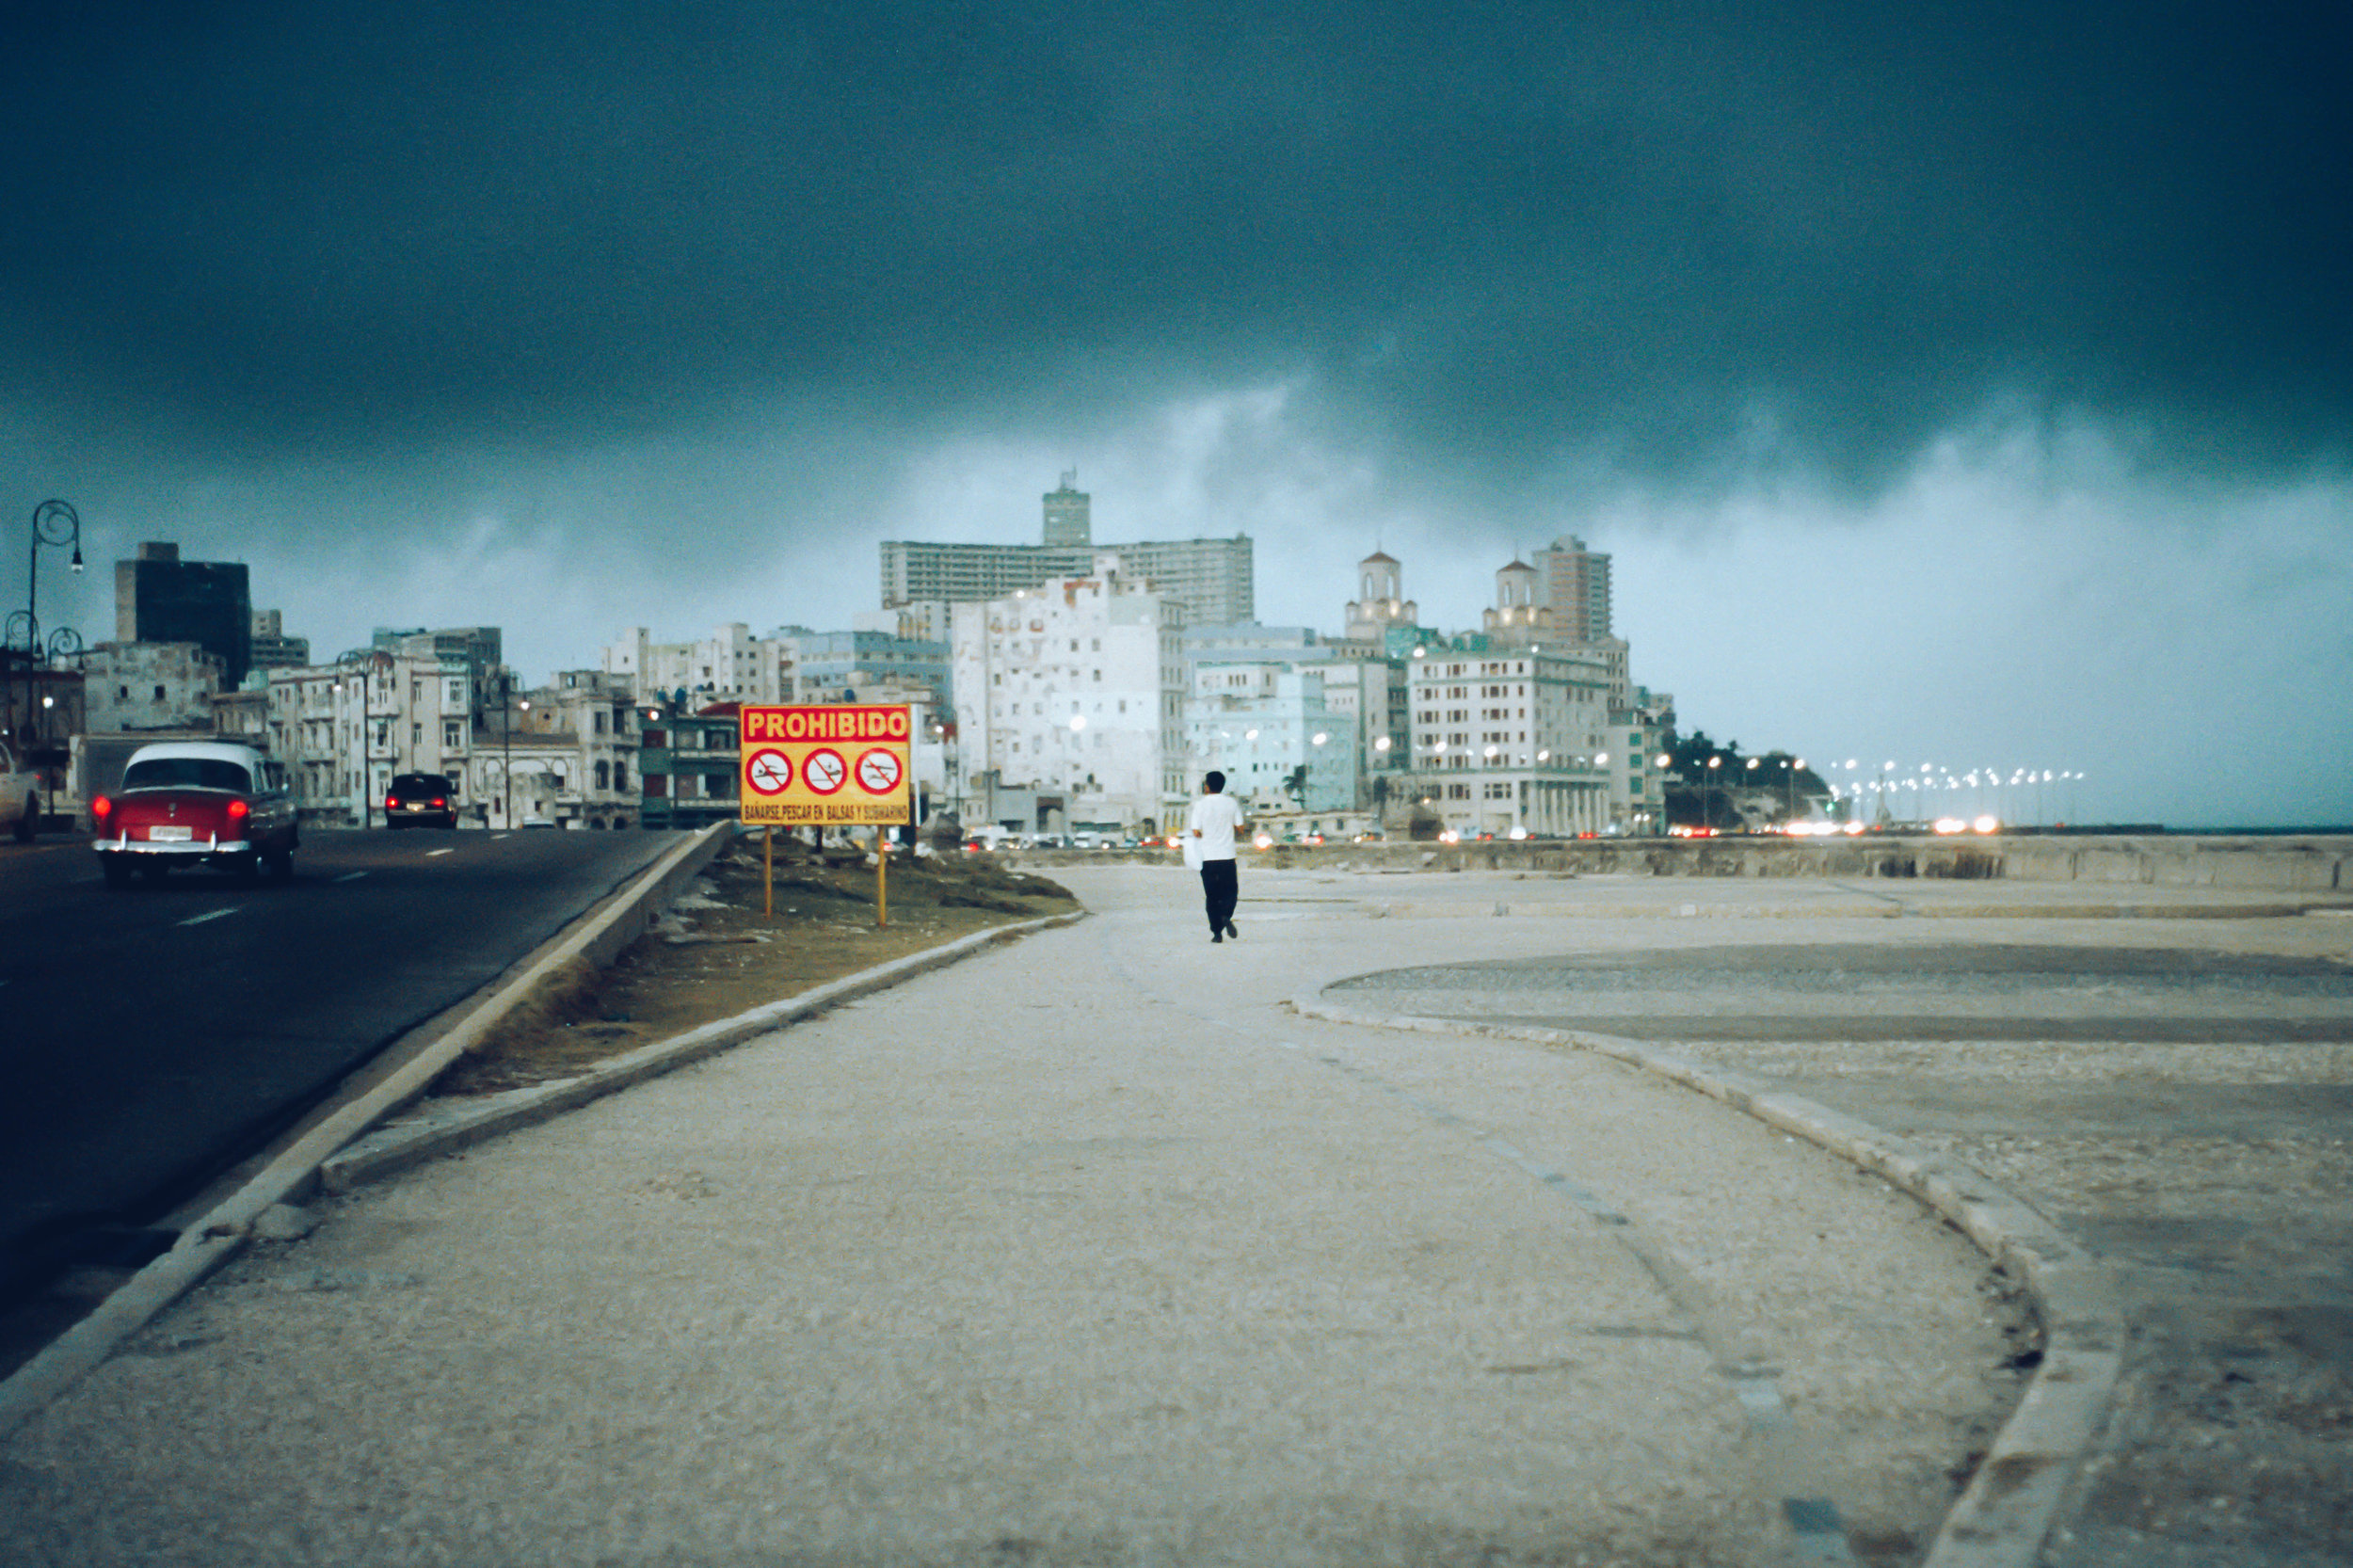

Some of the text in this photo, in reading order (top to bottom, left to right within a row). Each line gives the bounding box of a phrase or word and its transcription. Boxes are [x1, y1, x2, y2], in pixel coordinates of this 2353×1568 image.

[748, 712, 906, 737] PROHIBIDO
[814, 805, 824, 821] EN
[827, 805, 854, 821] BALSAS
